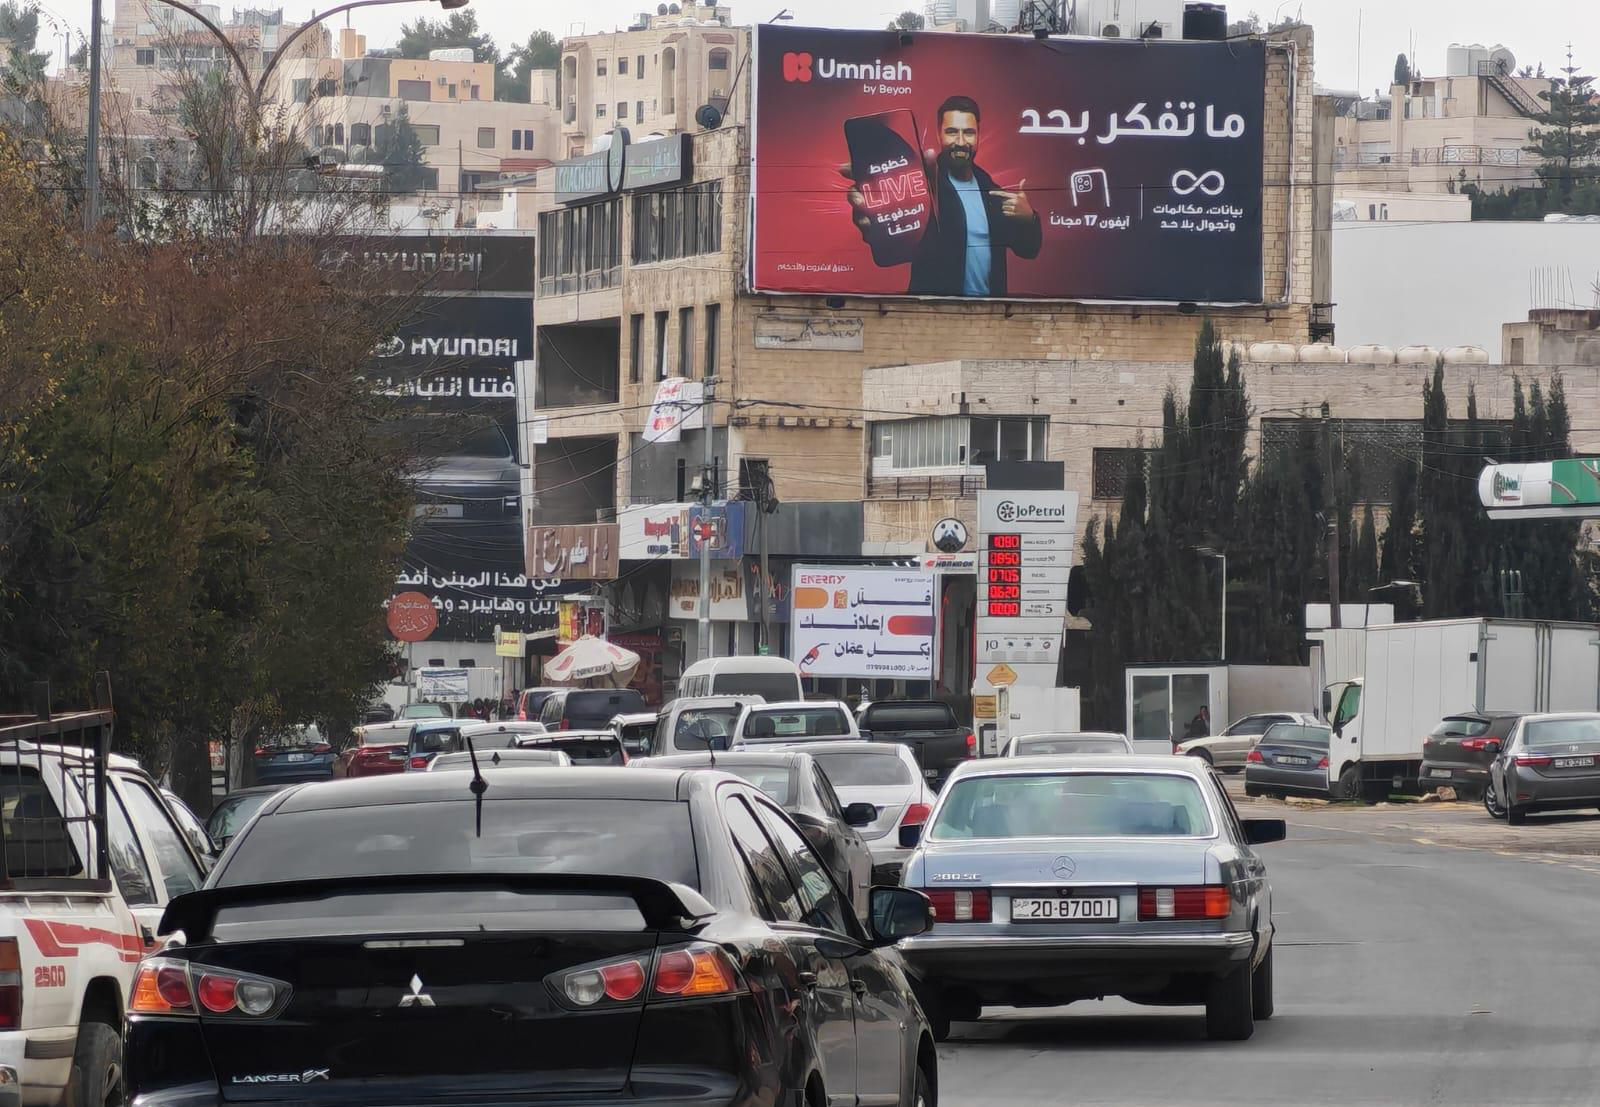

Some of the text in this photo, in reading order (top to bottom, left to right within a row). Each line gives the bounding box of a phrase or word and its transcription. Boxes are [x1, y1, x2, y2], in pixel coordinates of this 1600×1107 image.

[818, 58, 912, 81] Umniah
[863, 84, 912, 96] by Beyon
[1018, 101, 1245, 146] ما تفكر بحد
[869, 155, 909, 174] خطوط
[862, 170, 927, 208] LIVE
[877, 203, 925, 223] المدفوعة
[1152, 204, 1203, 215] مكالمات
[886, 219, 921, 236] لاحقاً
[1049, 210, 1130, 230] آيفون 17 مجاناً
[1160, 219, 1236, 232] وتجوال بلا حد
[411, 338, 518, 358] HYUNDAI
[469, 375, 516, 398] فتنا
[1016, 504, 1065, 519] JoPetrol
[431, 571, 490, 590] المبنى
[494, 571, 527, 588] هذا
[458, 596, 526, 615] وهايبرد
[867, 641, 931, 660] بكل
[1030, 900, 1112, 917] 20-87001
[34, 965, 66, 988] 2500
[232, 1068, 331, 1084] LANCER EX
